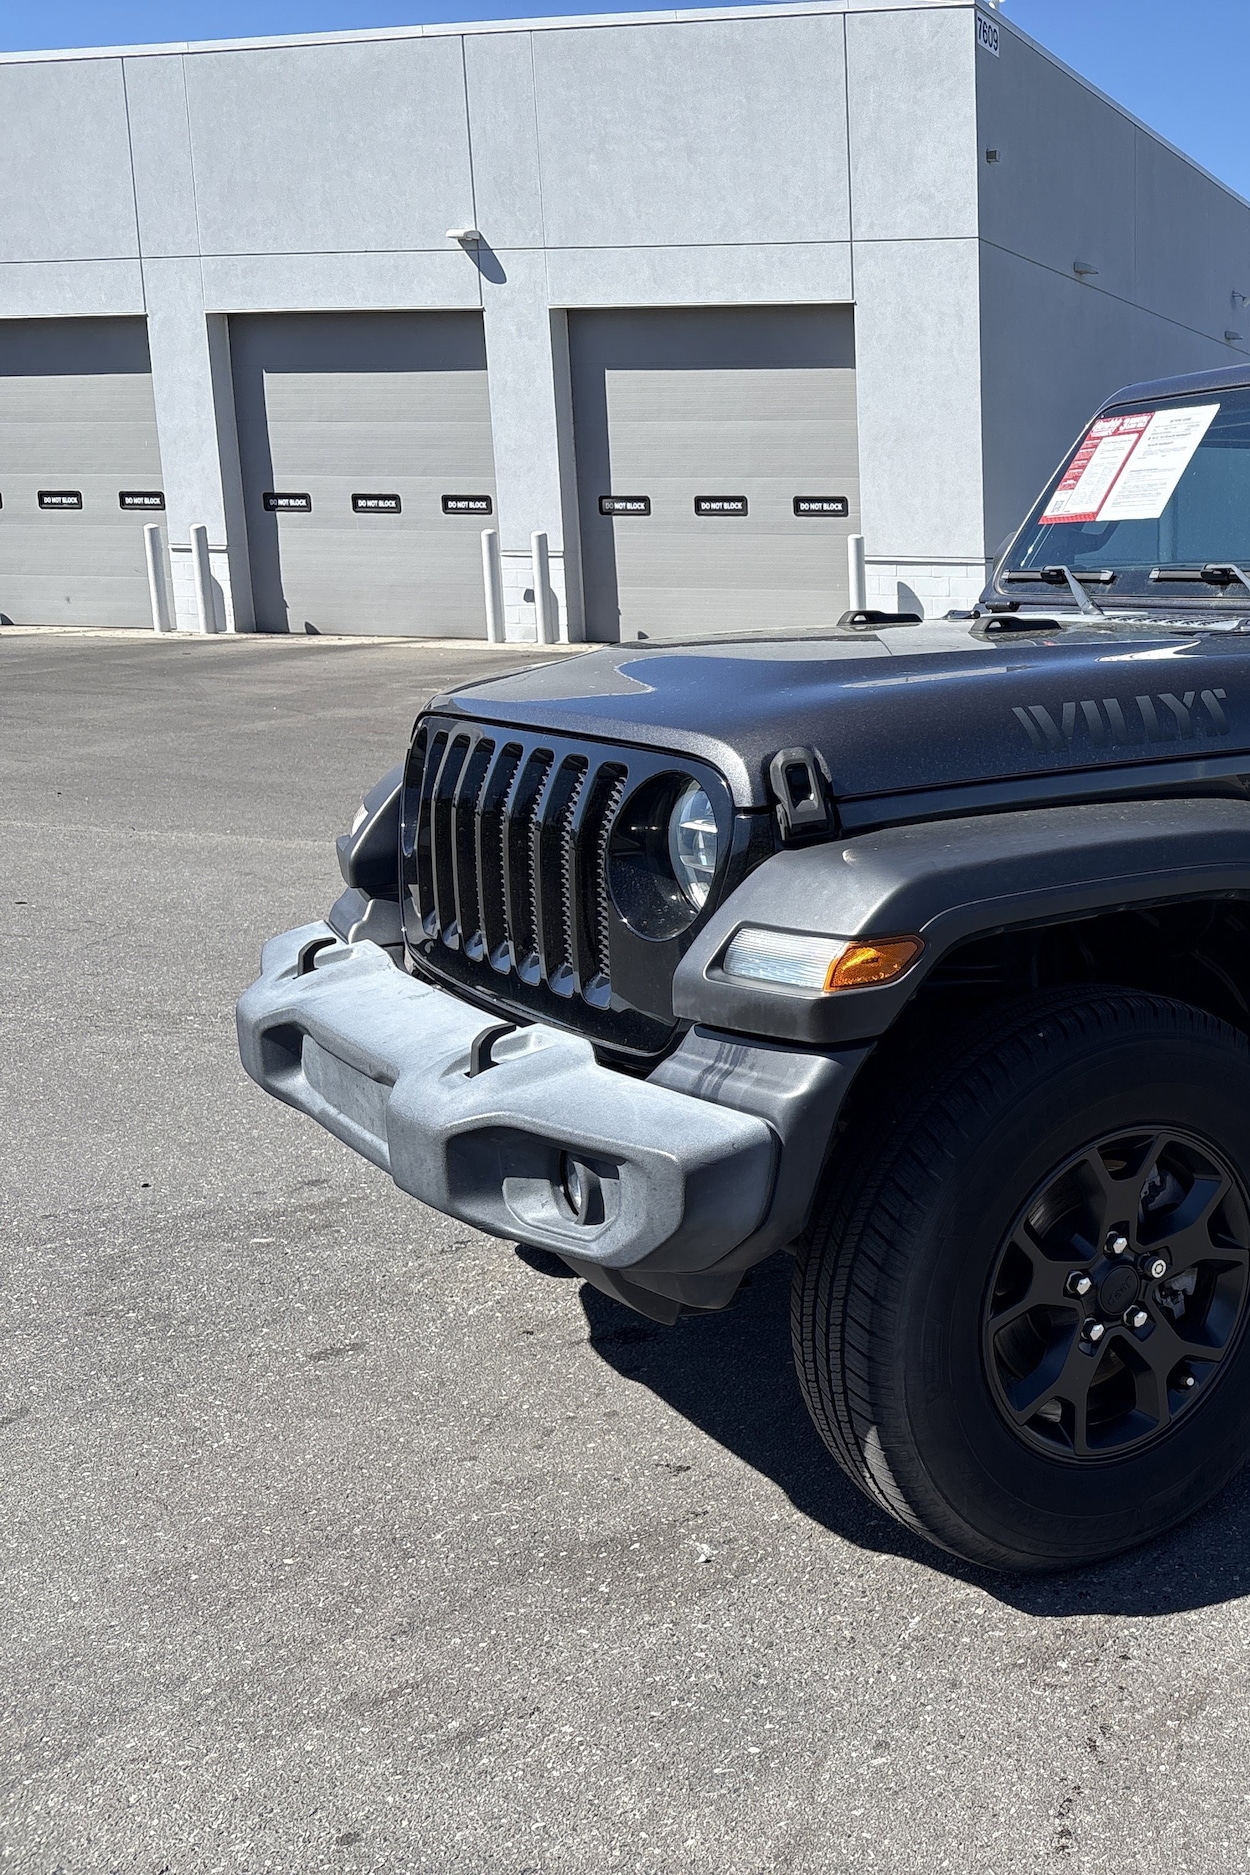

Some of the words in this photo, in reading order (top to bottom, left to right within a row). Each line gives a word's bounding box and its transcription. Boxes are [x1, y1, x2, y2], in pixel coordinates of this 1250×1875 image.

[977, 16, 998, 51] 7609
[144, 497, 161, 505] BLOCK
[270, 498, 277, 506] DO
[278, 498, 289, 506] NOT
[290, 498, 307, 506] BLOCK
[469, 501, 487, 509] BLOCK
[627, 502, 645, 510] BLOCK
[701, 502, 710, 510] DO
[711, 502, 723, 510] NOT
[724, 502, 743, 510] BLOCK
[800, 502, 809, 510] DO
[810, 502, 822, 510] NOT
[823, 502, 843, 510] BLOCK
[1012, 688, 1231, 752] WILLYS
